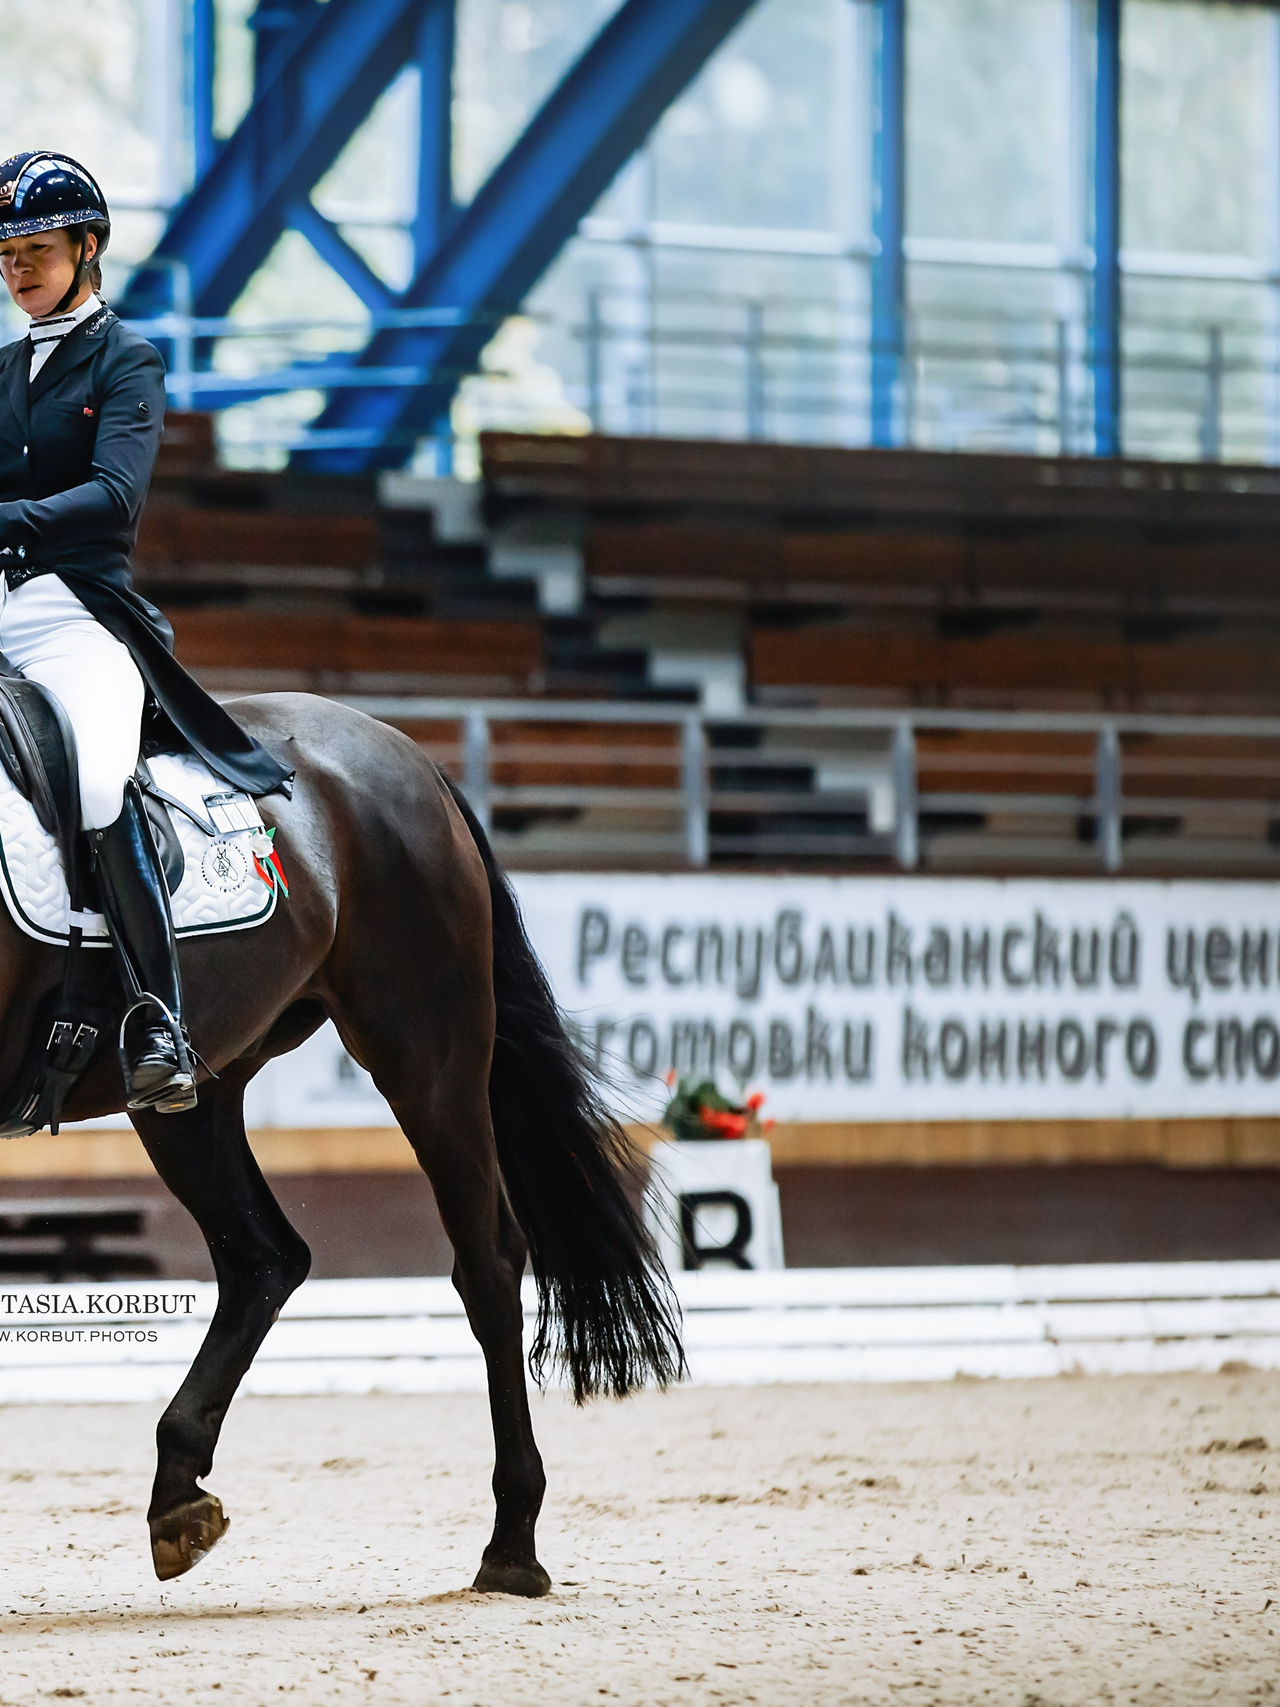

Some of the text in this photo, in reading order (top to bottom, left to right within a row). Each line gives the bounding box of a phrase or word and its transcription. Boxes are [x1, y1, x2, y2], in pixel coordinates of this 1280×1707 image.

[576, 907, 1280, 1001] Республиканский цен
[570, 1005, 873, 1080] готовки
[900, 1005, 1159, 1082] конного
